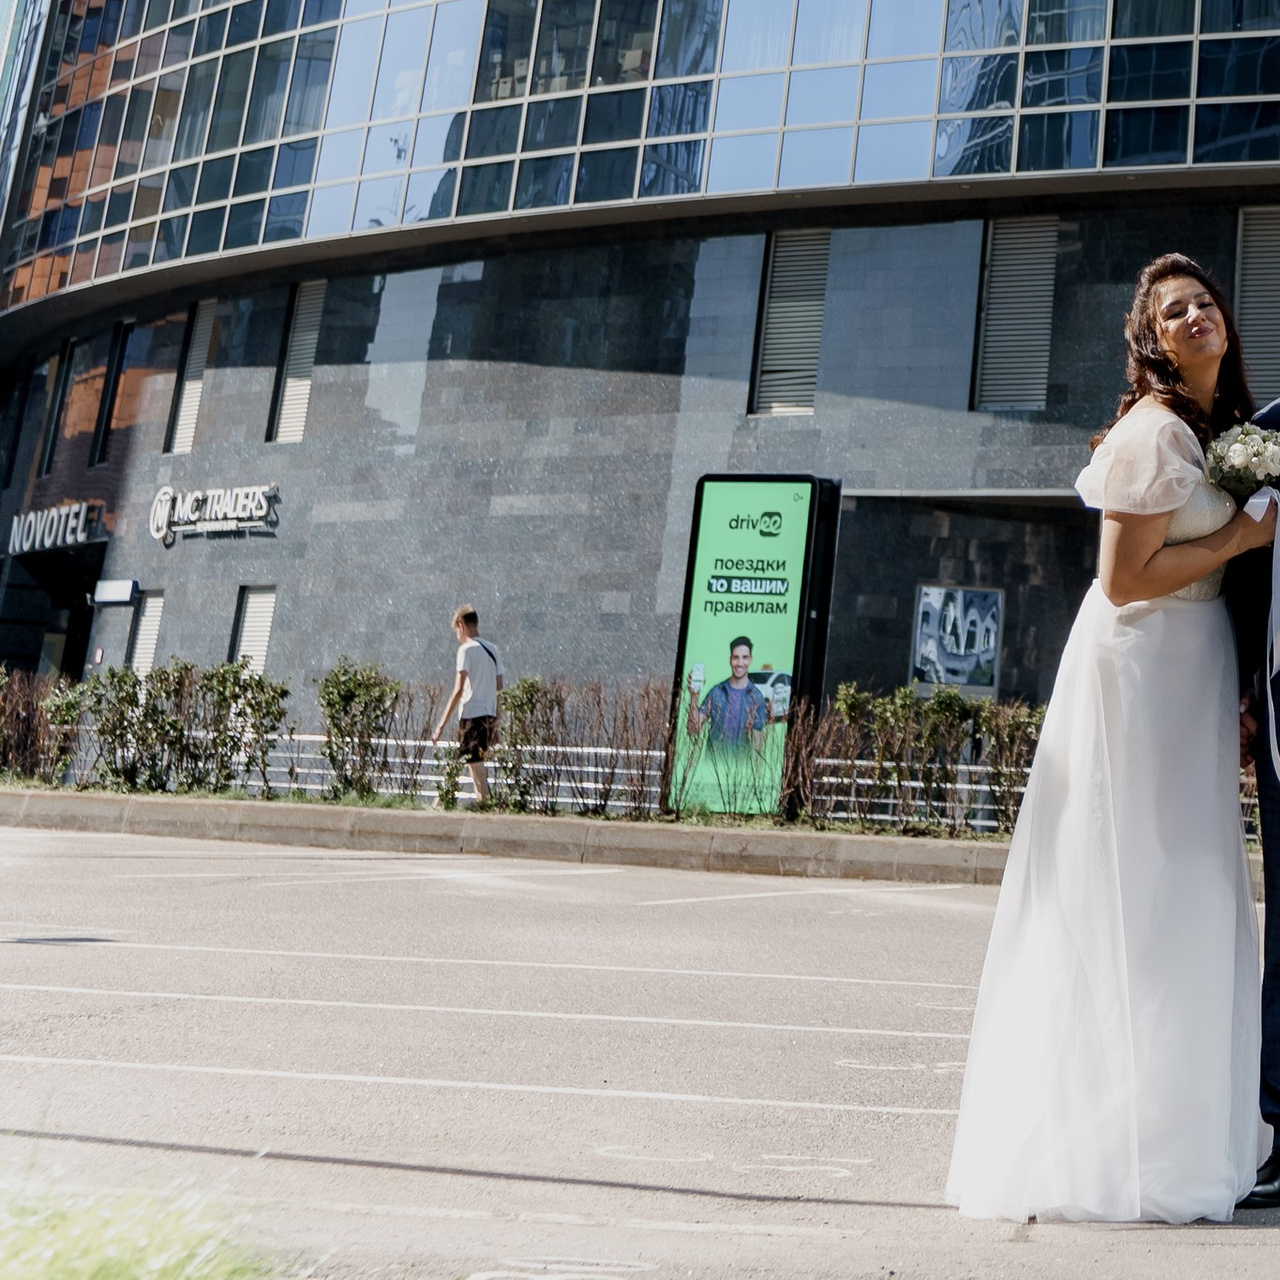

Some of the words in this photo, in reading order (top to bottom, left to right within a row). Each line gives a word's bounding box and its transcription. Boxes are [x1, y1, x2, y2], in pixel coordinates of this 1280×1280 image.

[174, 490, 202, 522] MC
[205, 485, 269, 520] TRADERS
[8, 501, 88, 554] NOVOTEL
[714, 558, 786, 574] поездки
[703, 600, 787, 616] правилам
